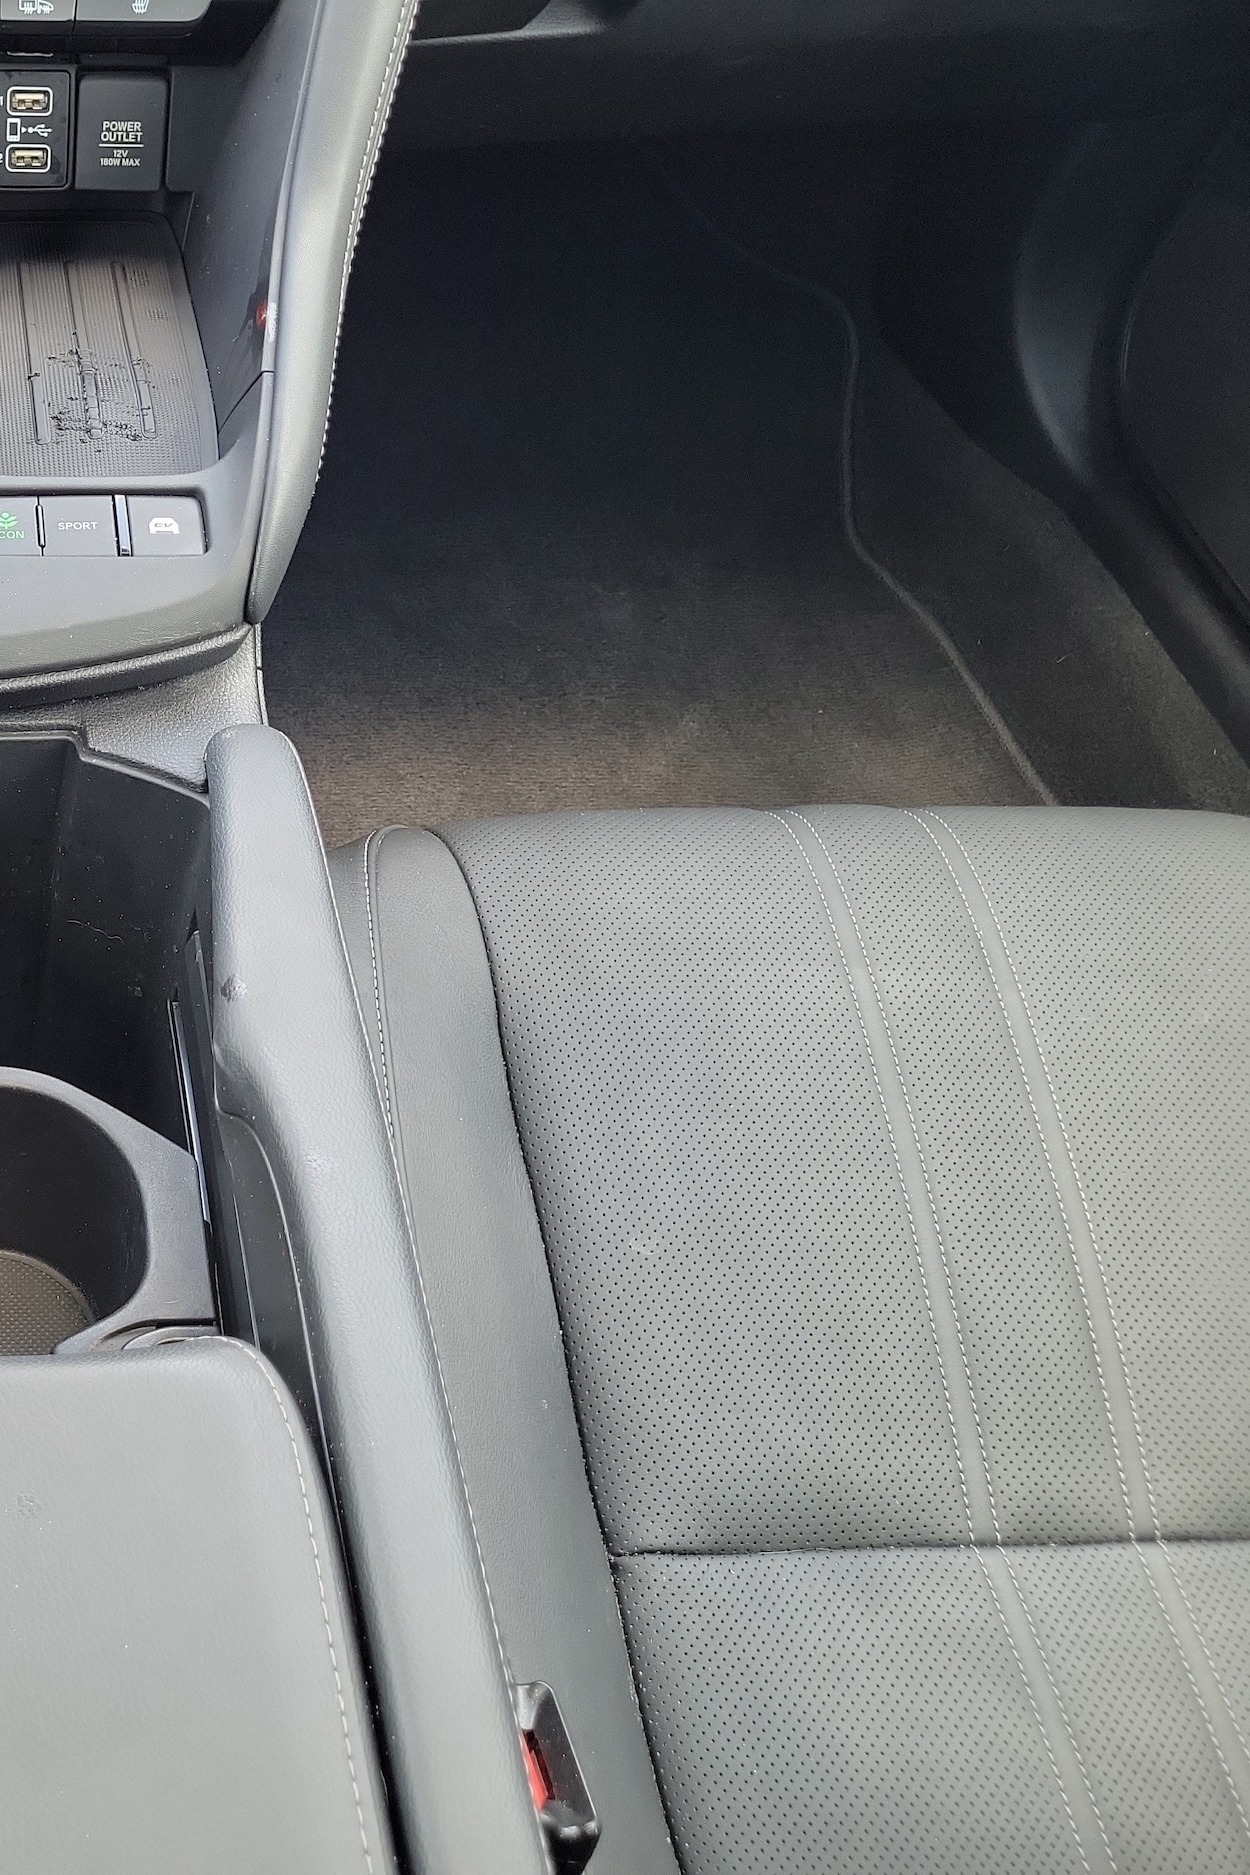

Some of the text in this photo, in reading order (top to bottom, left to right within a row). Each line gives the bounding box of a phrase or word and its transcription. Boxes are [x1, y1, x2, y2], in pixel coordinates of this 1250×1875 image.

[102, 121, 142, 132] POWER
[100, 131, 143, 142] OUTLET
[112, 149, 128, 158] 12V
[100, 157, 141, 166] 180W MAX
[57, 521, 98, 531] SPORT
